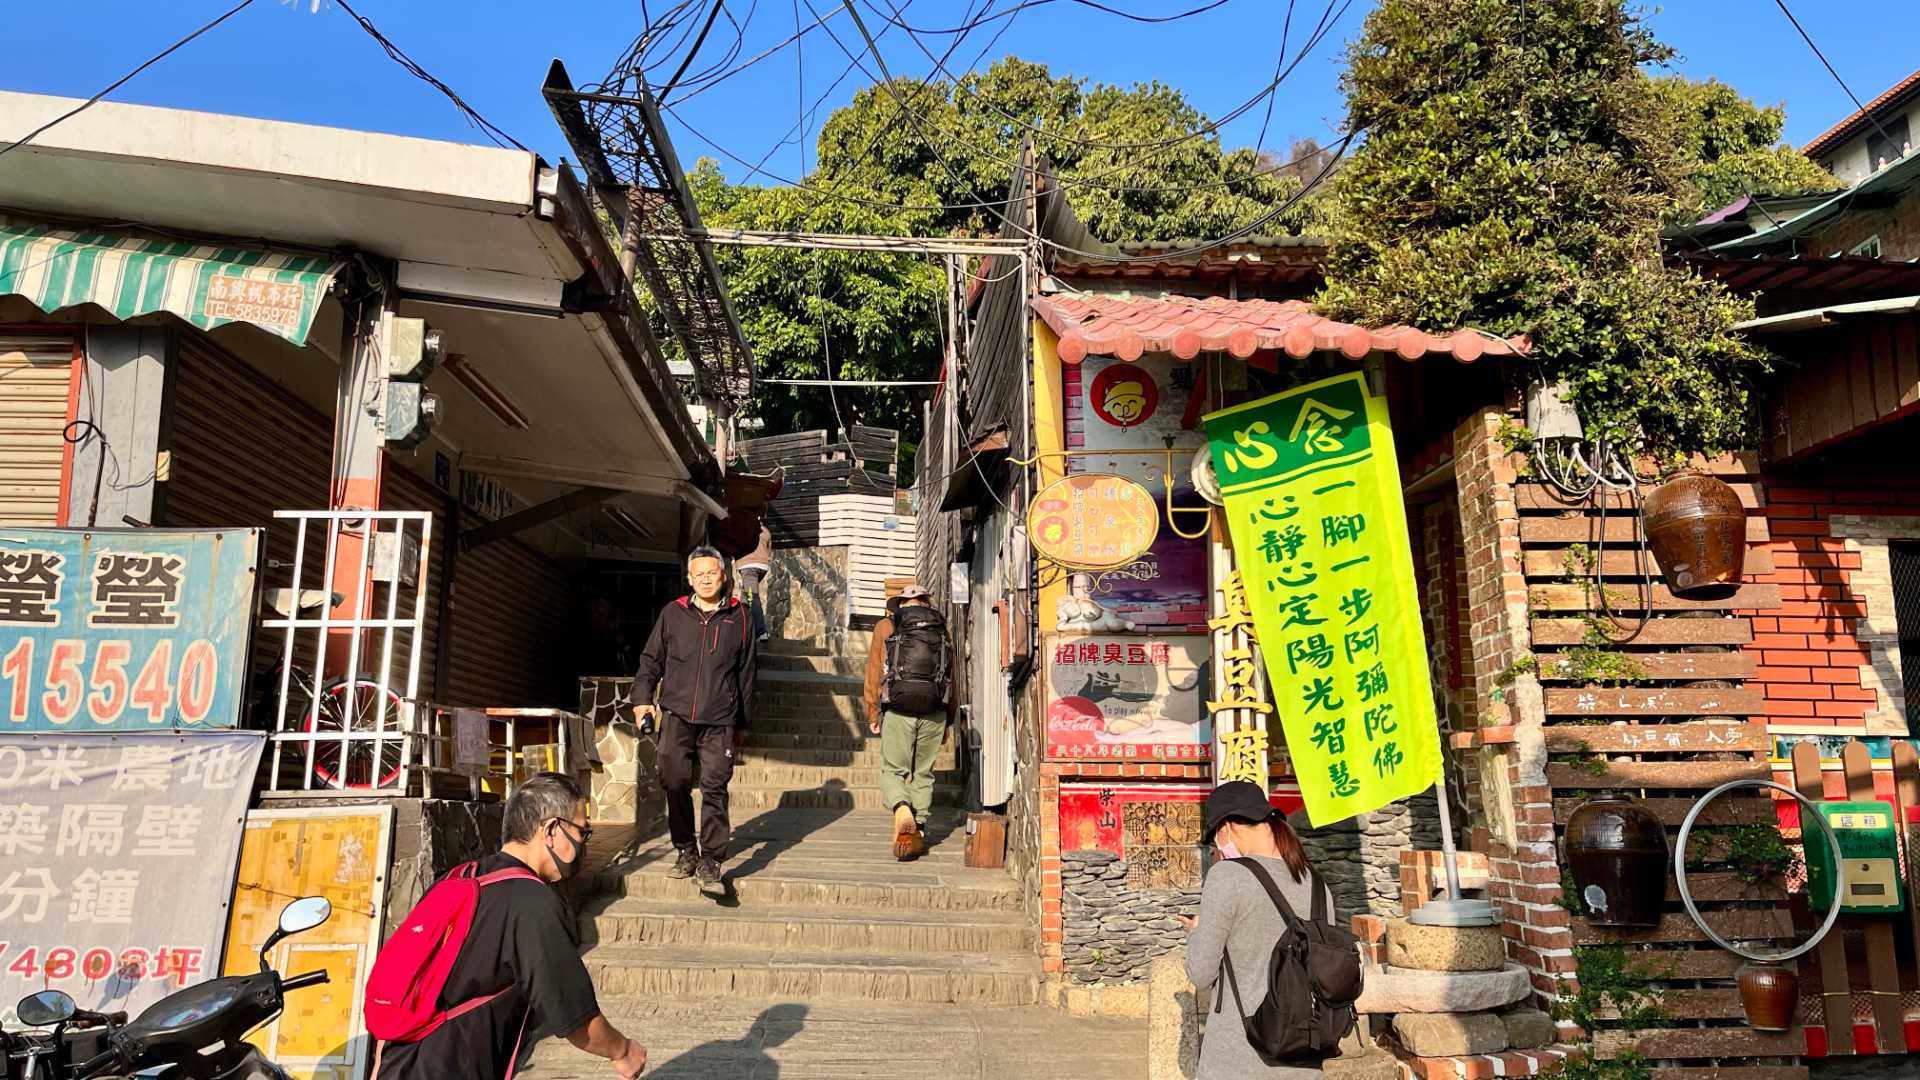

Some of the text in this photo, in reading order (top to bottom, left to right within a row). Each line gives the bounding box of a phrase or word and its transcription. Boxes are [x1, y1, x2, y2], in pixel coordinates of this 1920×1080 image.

[1055, 642, 1171, 666] 招牌臭豆腐
[1250, 495, 1361, 798] 心靜心定陽光智慧
[1312, 480, 1404, 779] 一腳一步阿彌陀佛
[1100, 788, 1117, 830] 柴山
